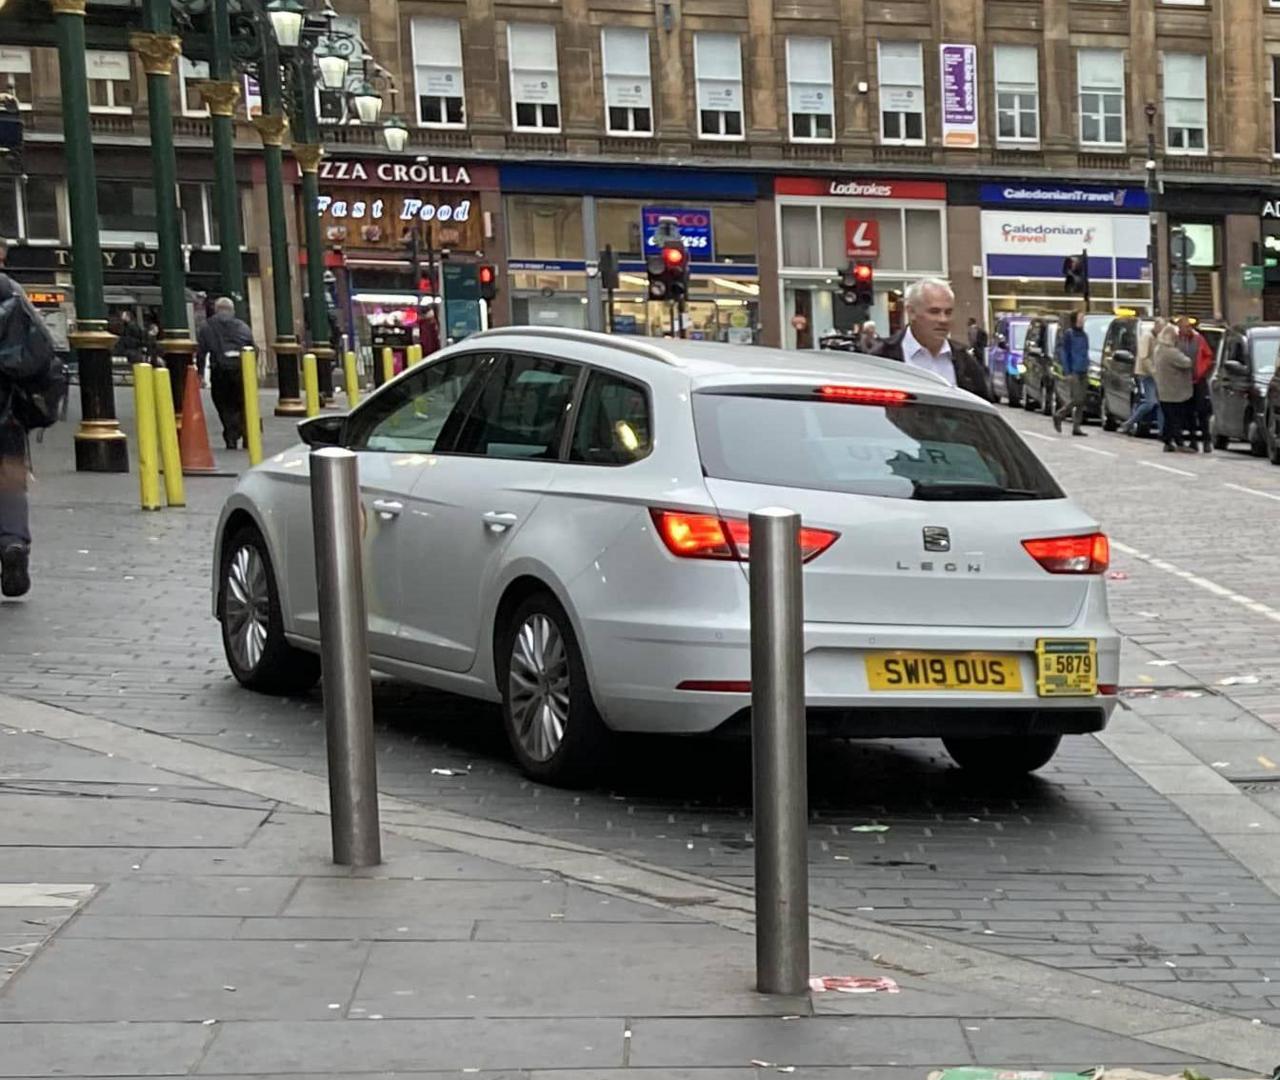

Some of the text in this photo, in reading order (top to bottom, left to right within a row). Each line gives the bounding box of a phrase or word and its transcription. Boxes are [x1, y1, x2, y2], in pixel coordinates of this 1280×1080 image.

[298, 162, 471, 184] ZZA CROLLA
[830, 182, 892, 196] Ladbrokes
[1003, 187, 1116, 202] CaledonianTravel
[317, 196, 471, 221] Fast Food
[852, 222, 872, 247] L
[1001, 222, 1084, 236] Caledonian
[1002, 233, 1048, 244] Travel
[897, 561, 980, 573] LEON
[884, 659, 1006, 686] SW19 OUS
[1056, 655, 1092, 674] 5879
